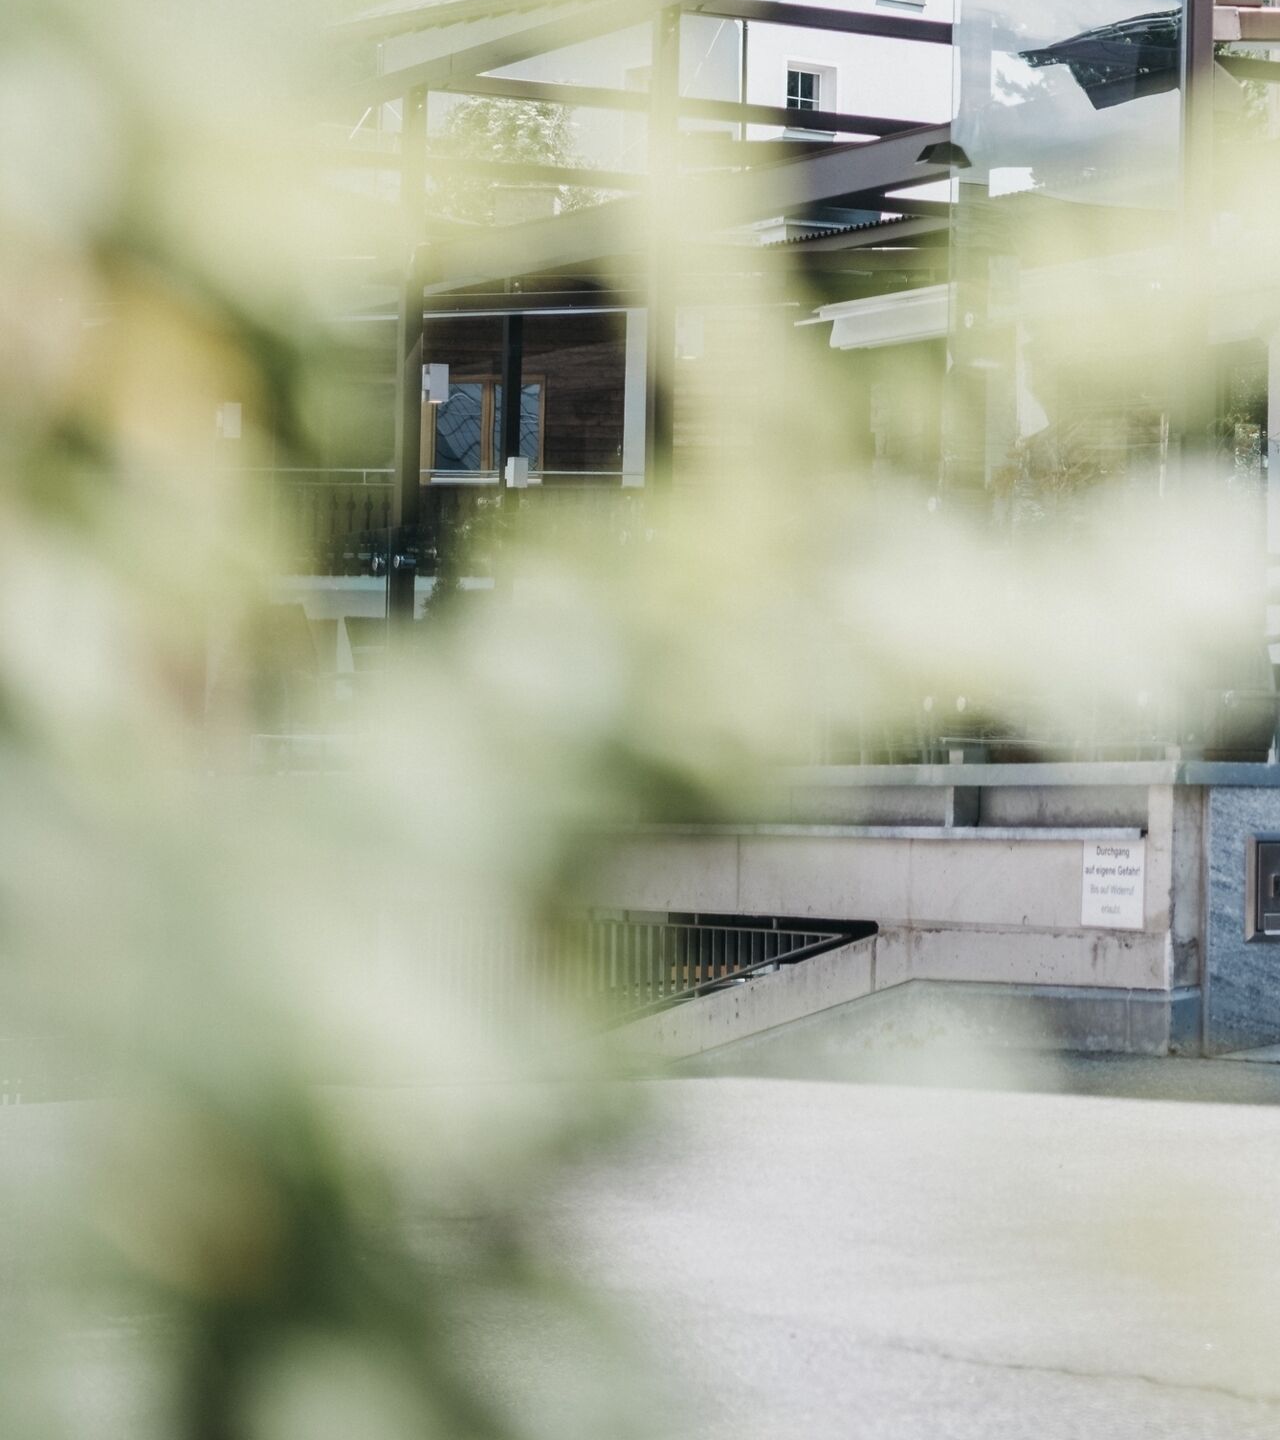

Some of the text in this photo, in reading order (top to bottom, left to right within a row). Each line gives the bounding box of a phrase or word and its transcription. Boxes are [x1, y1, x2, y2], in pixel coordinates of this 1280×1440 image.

[1096, 846, 1130, 859] Durchgang
[1085, 865, 1095, 875] auf
[1096, 867, 1116, 877] eigene
